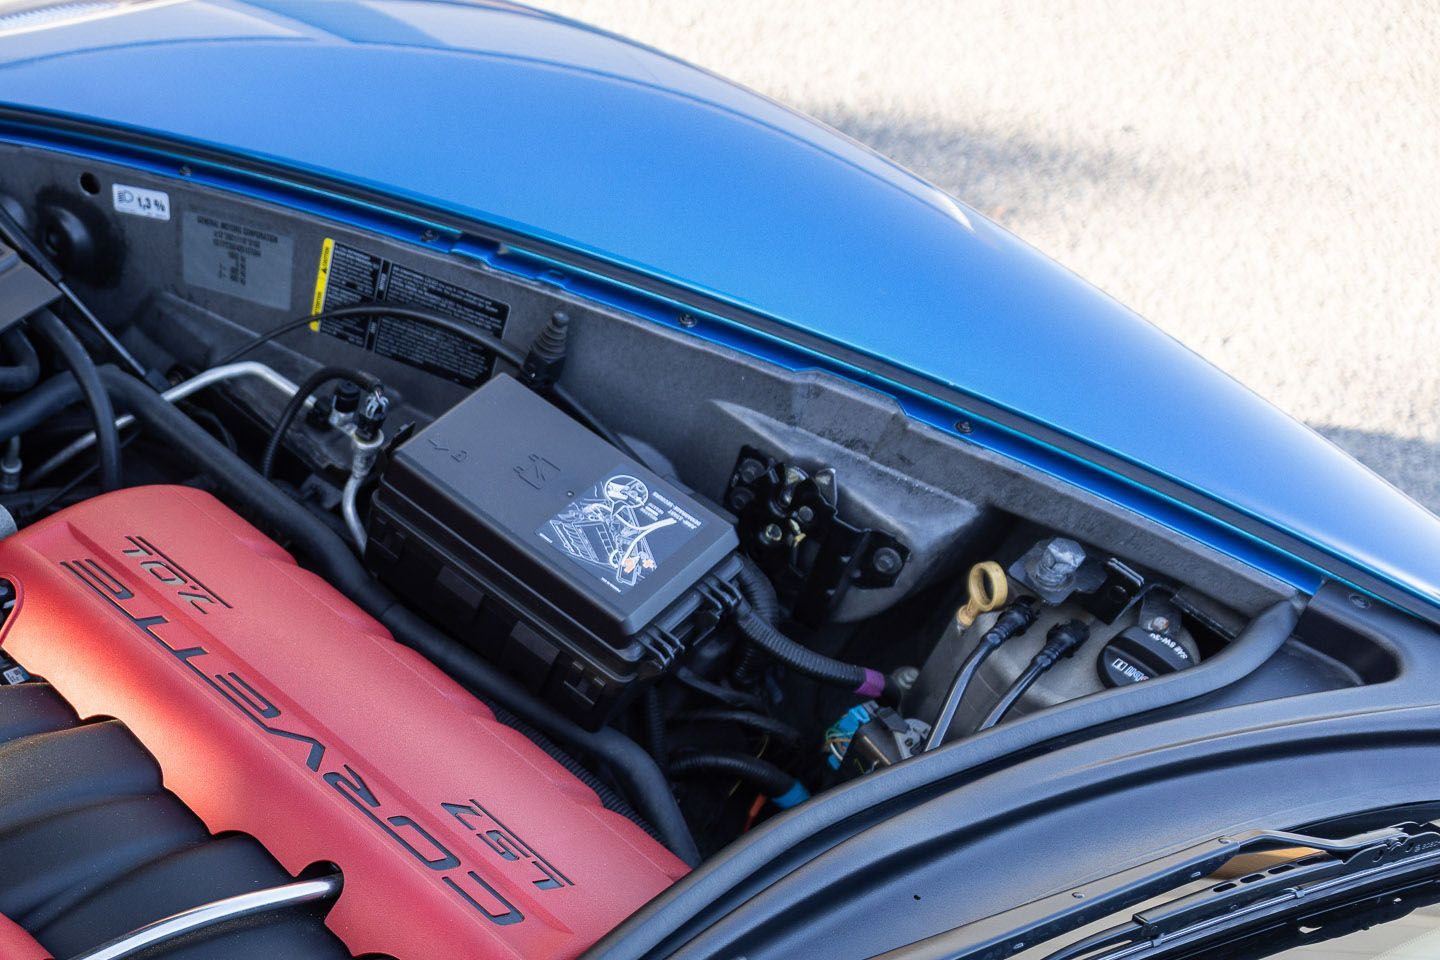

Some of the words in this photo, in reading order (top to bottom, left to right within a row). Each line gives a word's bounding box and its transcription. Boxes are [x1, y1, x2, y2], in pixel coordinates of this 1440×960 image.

[122, 535, 217, 615] 7.0L
[60, 558, 525, 927] CORVETTE
[442, 801, 565, 891] LS7
